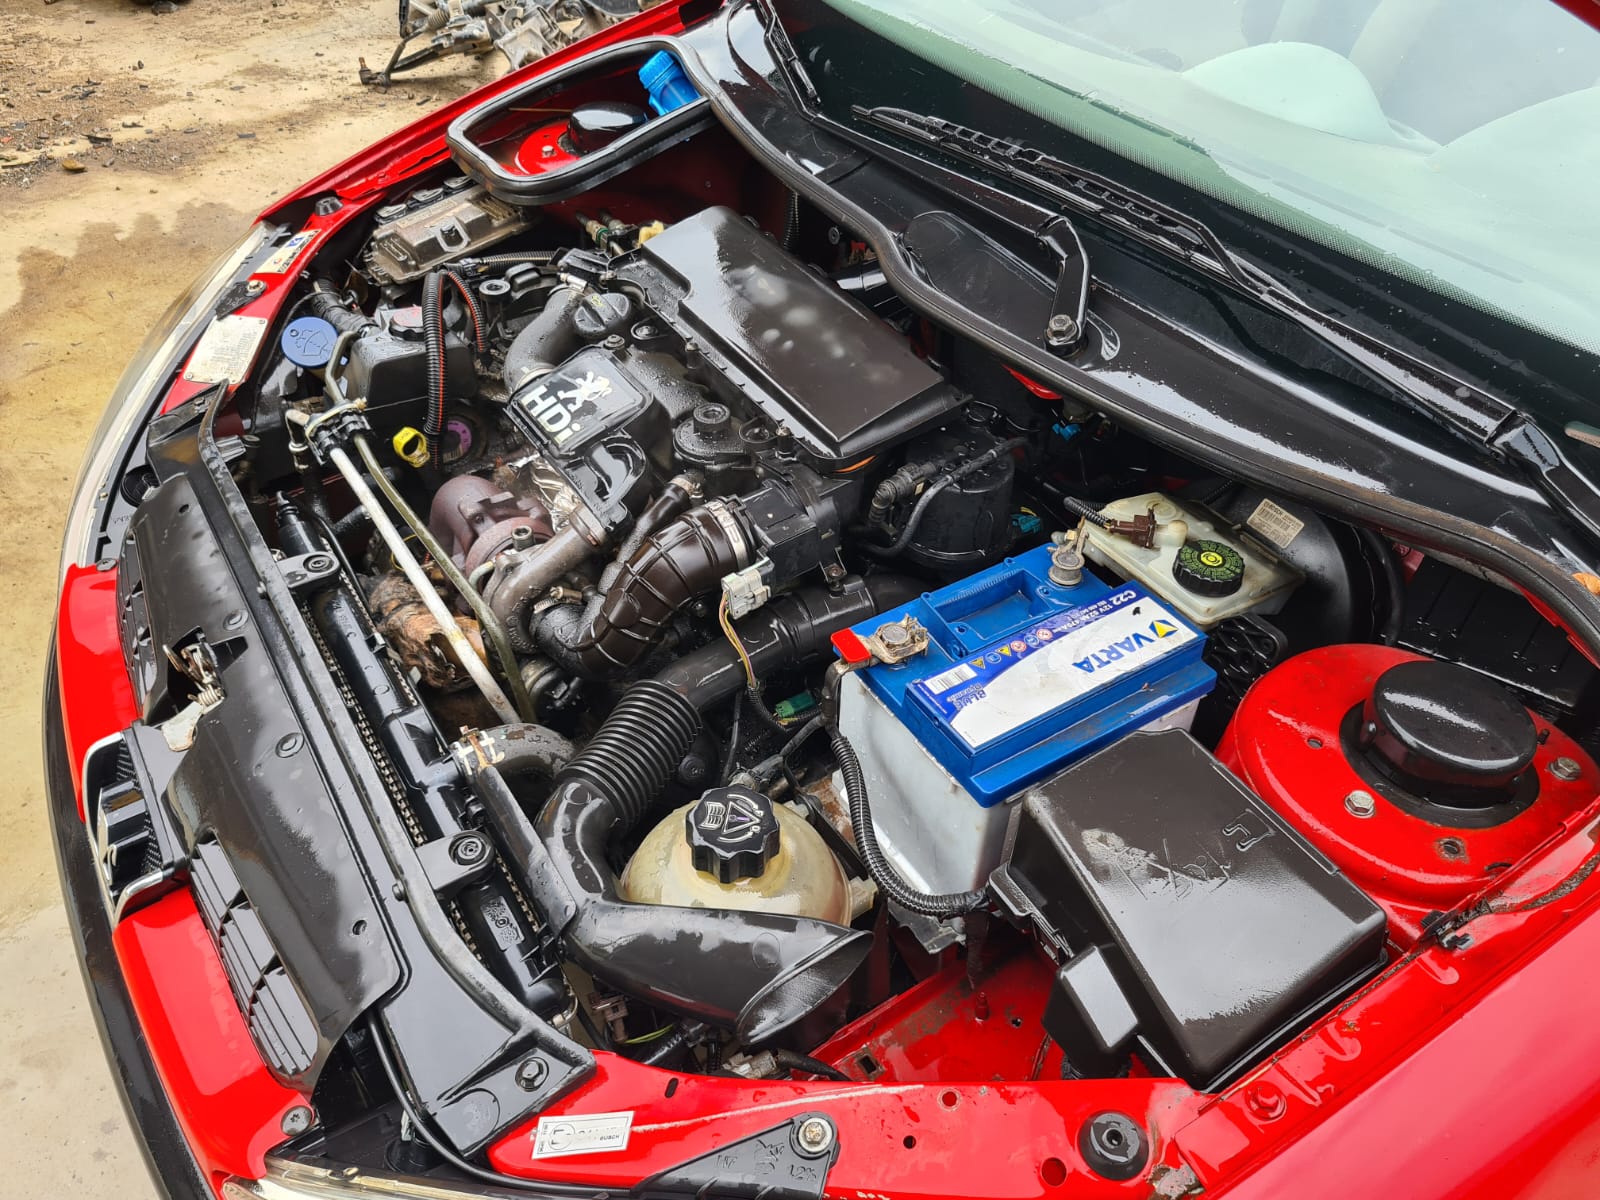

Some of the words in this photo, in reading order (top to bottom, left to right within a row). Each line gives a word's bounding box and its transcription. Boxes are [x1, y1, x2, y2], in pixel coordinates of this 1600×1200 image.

[520, 385, 581, 447] HDi
[1099, 604, 1113, 614] 12V
[1108, 590, 1137, 606] C22
[1072, 632, 1156, 673] VARTA
[952, 688, 987, 712] BLUE
